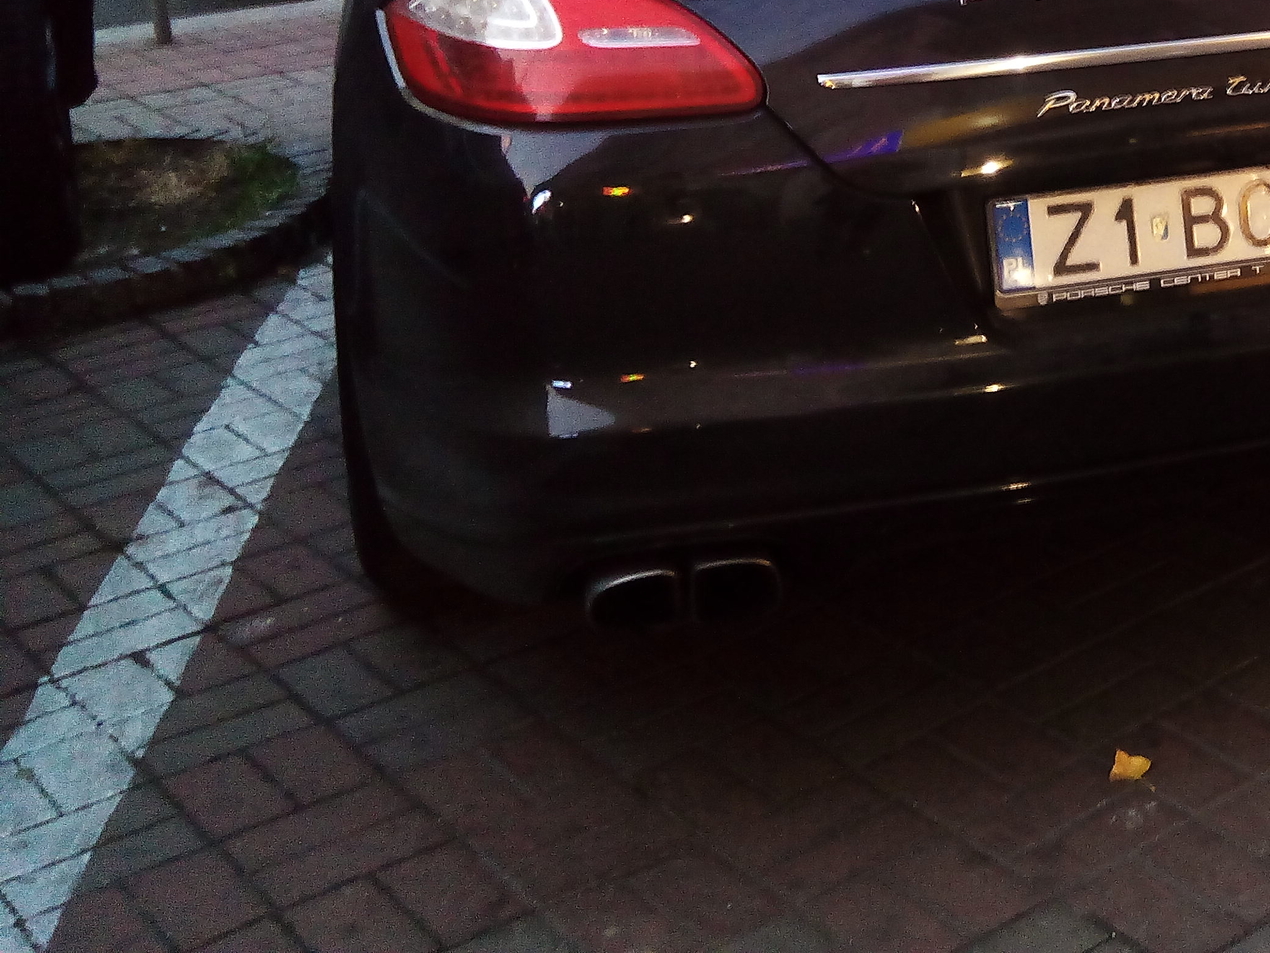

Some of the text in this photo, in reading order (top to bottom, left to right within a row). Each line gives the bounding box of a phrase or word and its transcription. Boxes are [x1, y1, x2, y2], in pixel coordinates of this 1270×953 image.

[1036, 85, 1214, 119] Panamera
[1047, 197, 1140, 277] Z1
[1051, 280, 1150, 303] PORSCHE
[1160, 267, 1241, 288] CENTER
